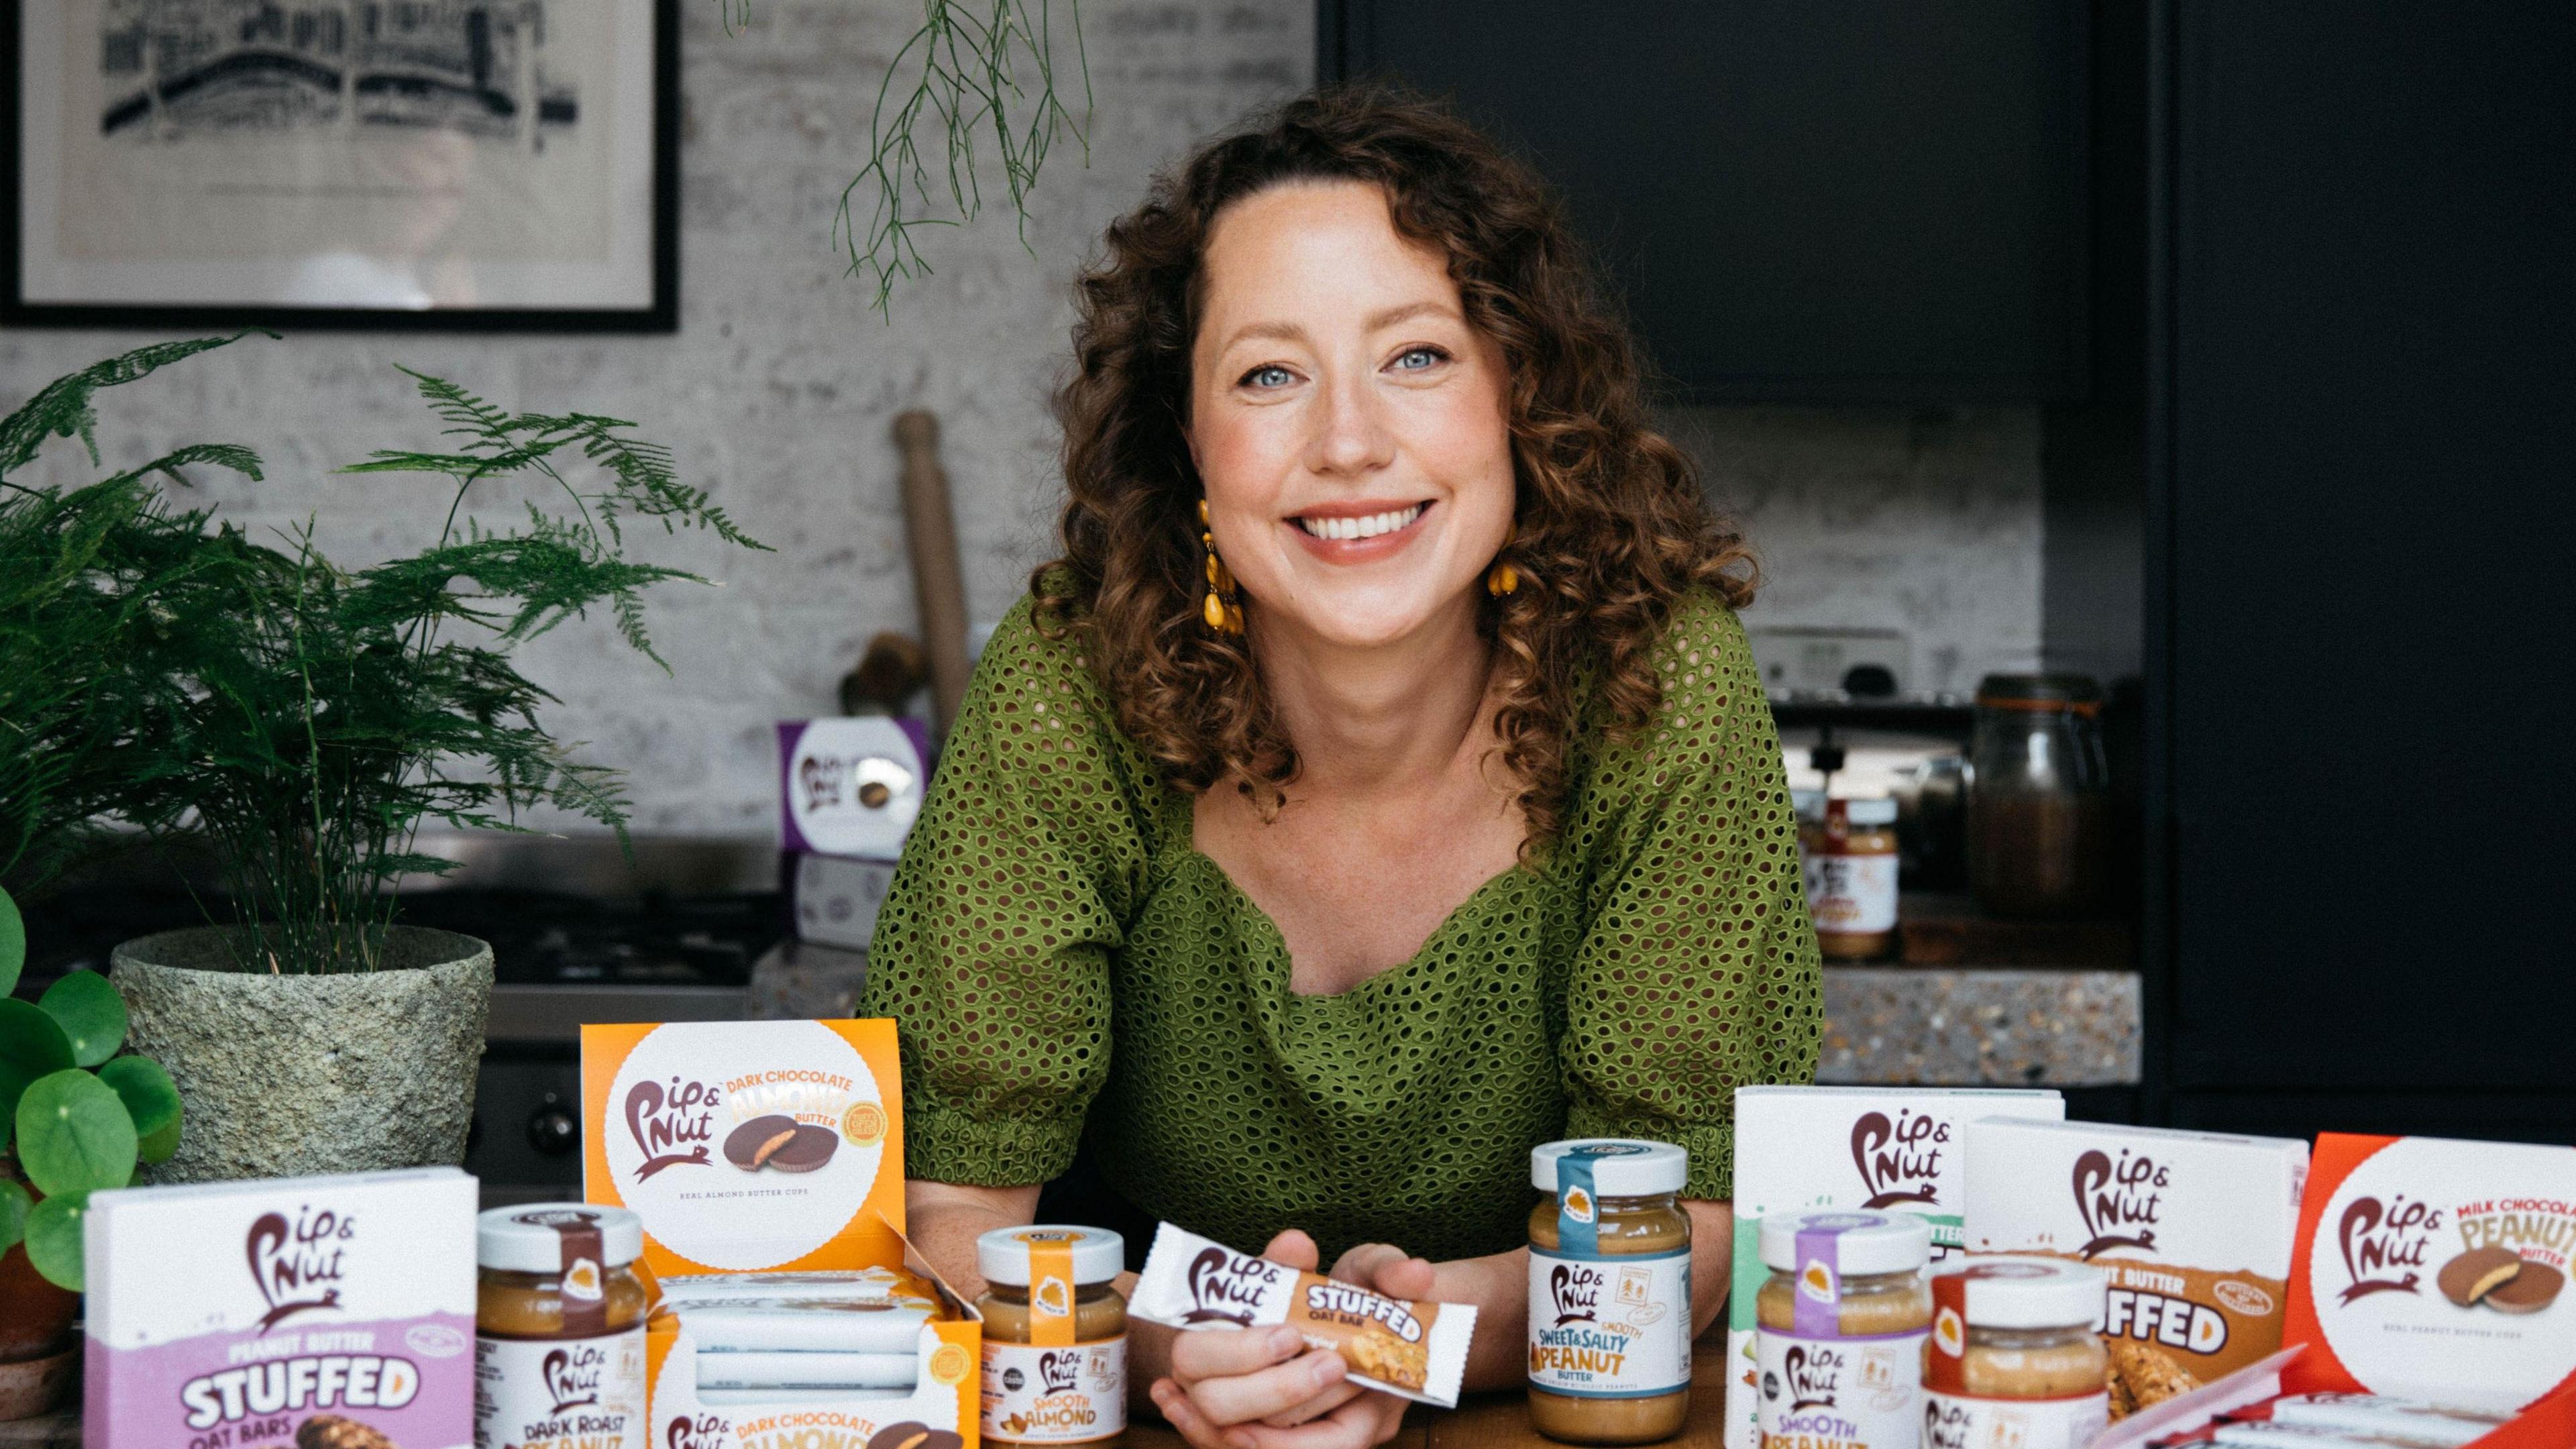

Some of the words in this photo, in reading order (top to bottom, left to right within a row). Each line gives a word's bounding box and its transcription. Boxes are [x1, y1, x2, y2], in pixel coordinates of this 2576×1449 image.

[726, 1073, 763, 1093] DARK
[765, 1069, 853, 1091] CHOCOLATE
[649, 1112, 713, 1153] Nut
[795, 1113, 837, 1128] BUTTER
[1876, 1148, 1942, 1189] Nut
[706, 1191, 745, 1199] ALMOND
[748, 1189, 782, 1197] BUTTER
[2097, 1190, 2161, 1230] Nut
[2457, 1200, 2493, 1219] MILK
[2360, 1235, 2430, 1275] Nut
[2519, 1247, 2565, 1267] BUTTER
[276, 1249, 343, 1297] Nut
[2124, 1268, 2186, 1295] BUTTER
[1205, 1276, 1268, 1310] Nut
[1562, 1287, 1599, 1309] Nut
[1307, 1284, 1423, 1343] STUFFED
[1309, 1310, 1335, 1322] OAT
[1339, 1313, 1364, 1327] BAR
[1601, 1322, 1644, 1340] SMOOTH
[1540, 1346, 1625, 1376] PEANUT
[559, 1371, 601, 1396] Nut
[1051, 1367, 1078, 1385] Nut
[1557, 1370, 1593, 1382] BUTTER
[1799, 1372, 1838, 1395] Nut
[180, 1354, 421, 1432] STUFFED
[1033, 1395, 1090, 1411] SMOOTH
[524, 1418, 573, 1440] DARK
[578, 1415, 625, 1434] ROAST
[737, 1416, 777, 1440] DARK
[780, 1412, 876, 1436] CHOCOLATE
[1025, 1408, 1097, 1428] ALMOND
[1778, 1414, 1858, 1438] SMOOTH
[189, 1430, 231, 1449] OAT
[239, 1415, 292, 1444] BARS
